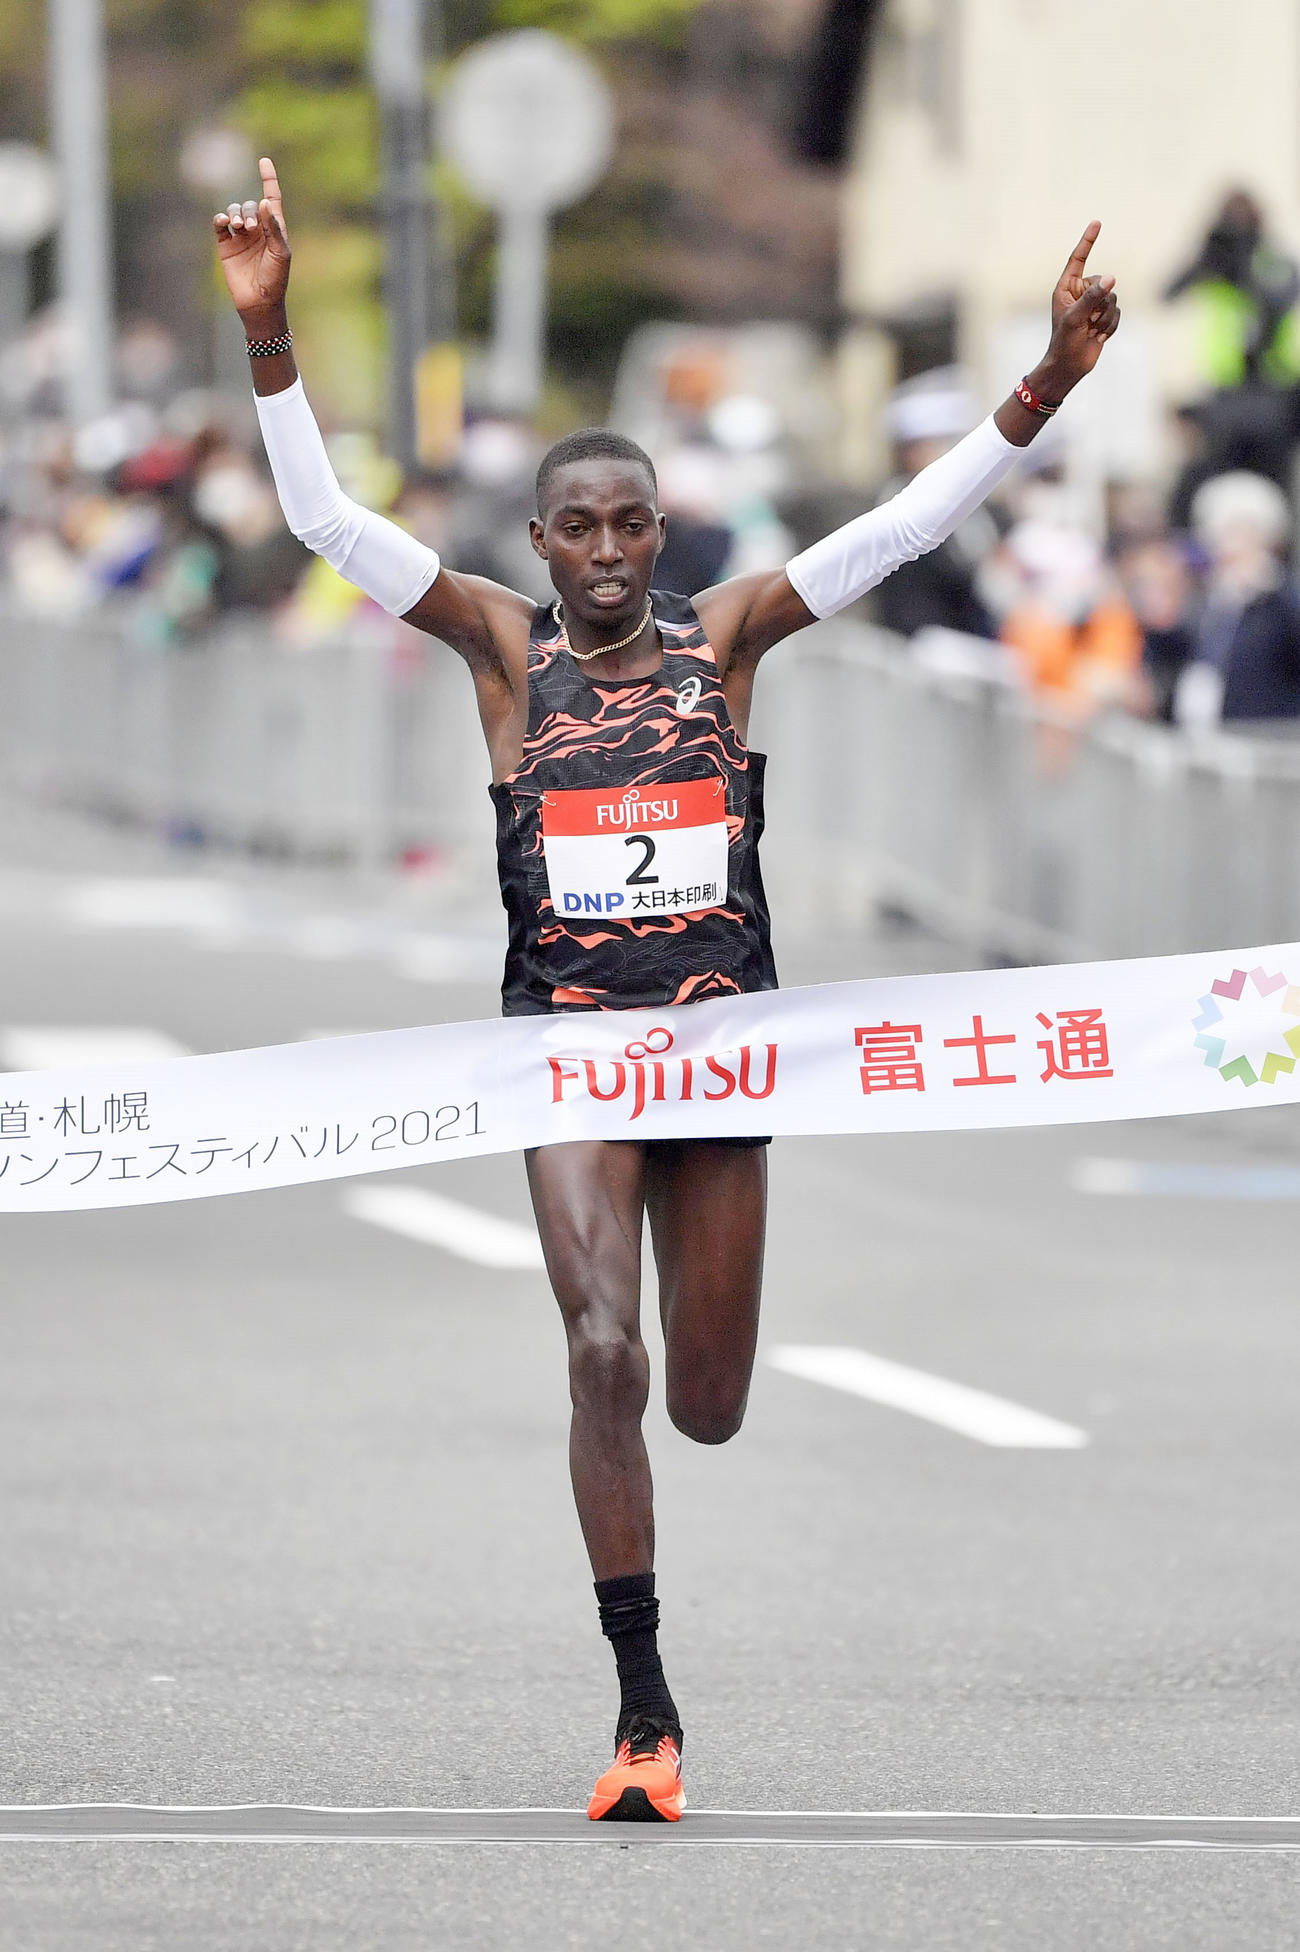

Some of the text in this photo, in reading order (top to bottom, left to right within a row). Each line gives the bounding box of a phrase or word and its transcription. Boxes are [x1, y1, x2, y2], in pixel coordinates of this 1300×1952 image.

[596, 789, 679, 831] FUJITSU
[624, 834, 660, 886] 2
[563, 881, 718, 913] DNP 大日本印刷
[545, 1008, 1115, 1121] FUJITSU 富士通
[370, 1100, 487, 1152] 2021
